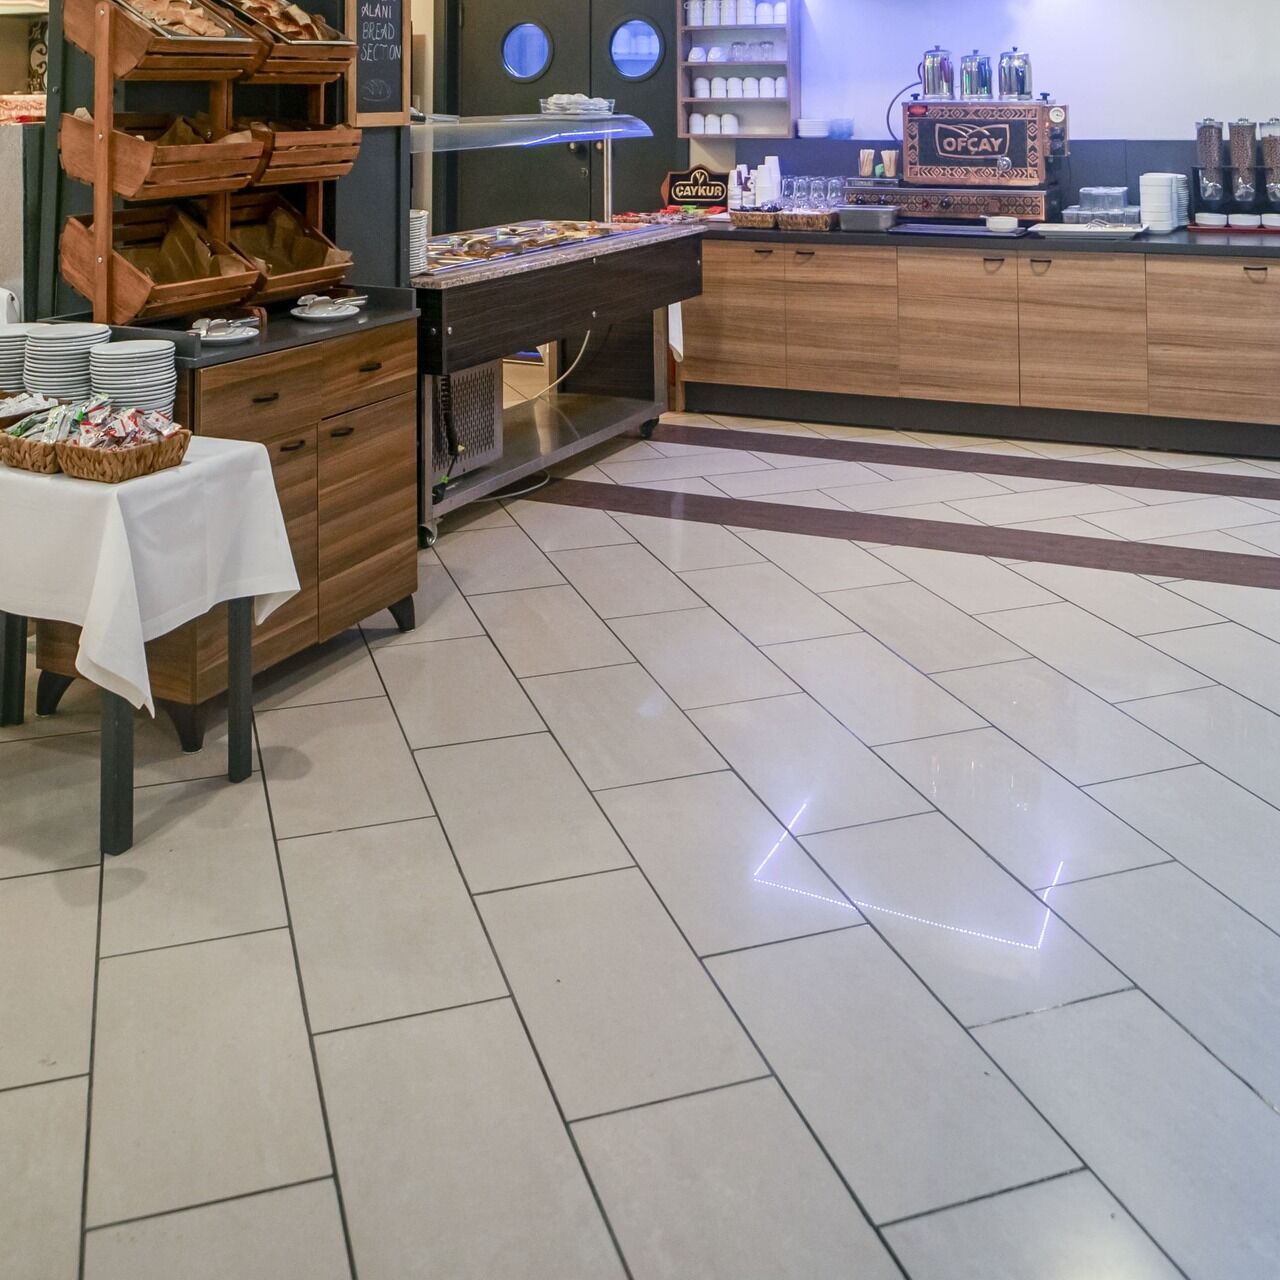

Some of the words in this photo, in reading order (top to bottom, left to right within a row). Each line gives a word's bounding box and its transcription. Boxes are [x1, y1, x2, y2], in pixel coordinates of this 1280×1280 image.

[361, 2, 393, 19] ALANI
[362, 21, 395, 41] BREAD
[360, 43, 402, 62] SECTON
[942, 137, 1003, 155] OFÇAY
